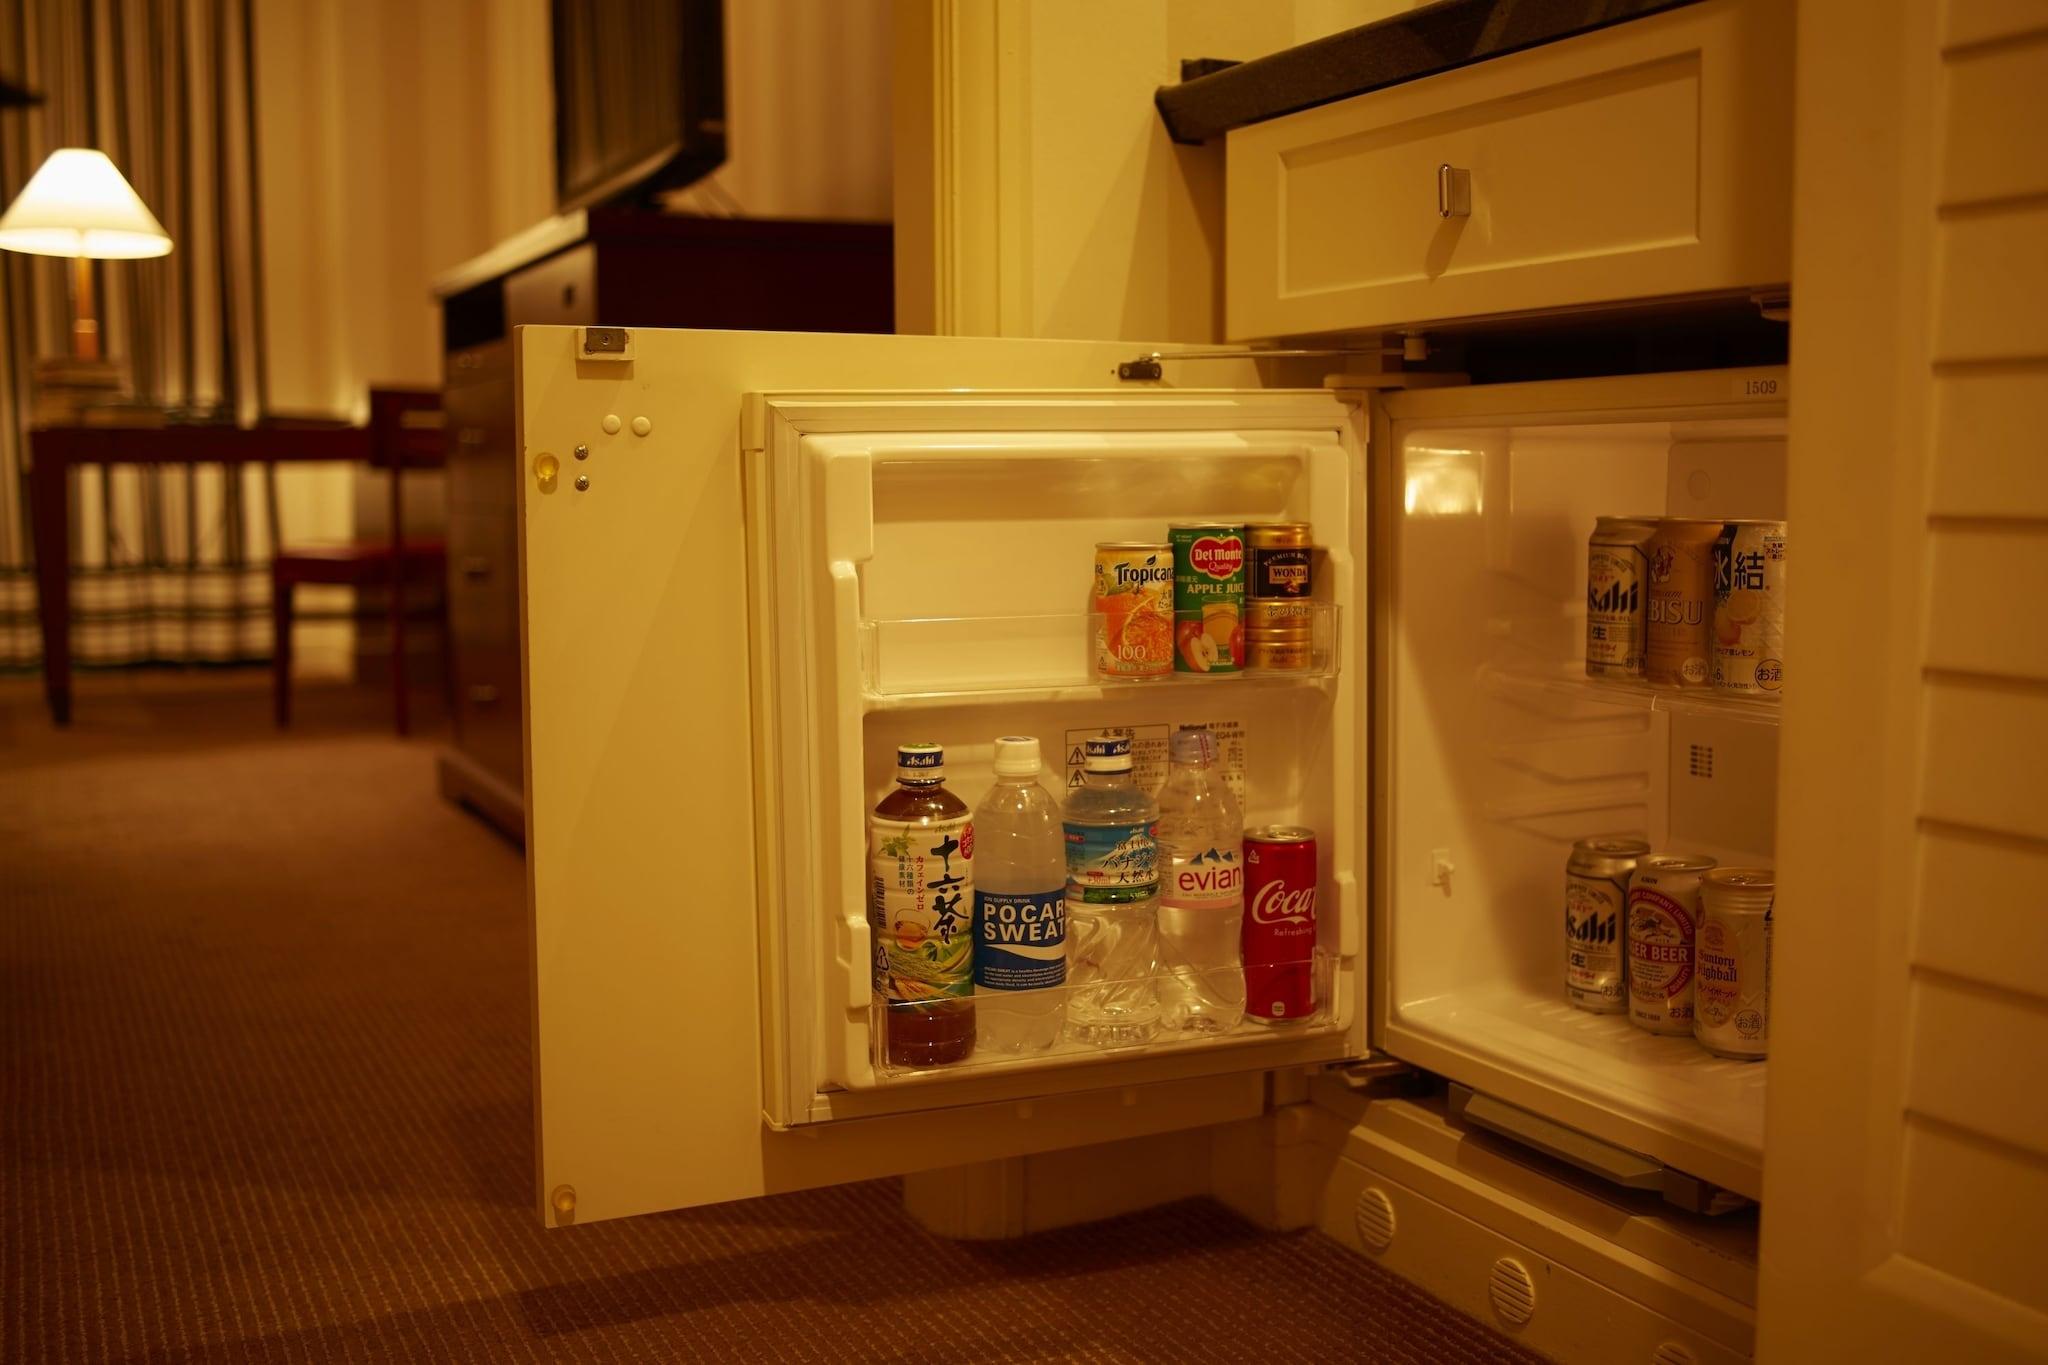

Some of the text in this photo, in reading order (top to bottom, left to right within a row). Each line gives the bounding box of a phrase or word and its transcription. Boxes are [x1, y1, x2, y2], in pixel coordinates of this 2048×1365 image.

[1746, 380, 1777, 395] 1509
[1194, 549, 1212, 561] Del
[1187, 583, 1224, 594] APPLE
[1588, 580, 1639, 614] sahi
[1649, 600, 1704, 625] BISU
[906, 755, 935, 766] Asahi
[915, 855, 925, 911] カフェインゼロ
[926, 834, 970, 945] 十六茶
[1178, 866, 1242, 892] evian
[983, 899, 1064, 924] POCAR
[983, 917, 1065, 943] SWEAT
[1566, 911, 1616, 944] sahi
[1652, 945, 1688, 963] BEER
